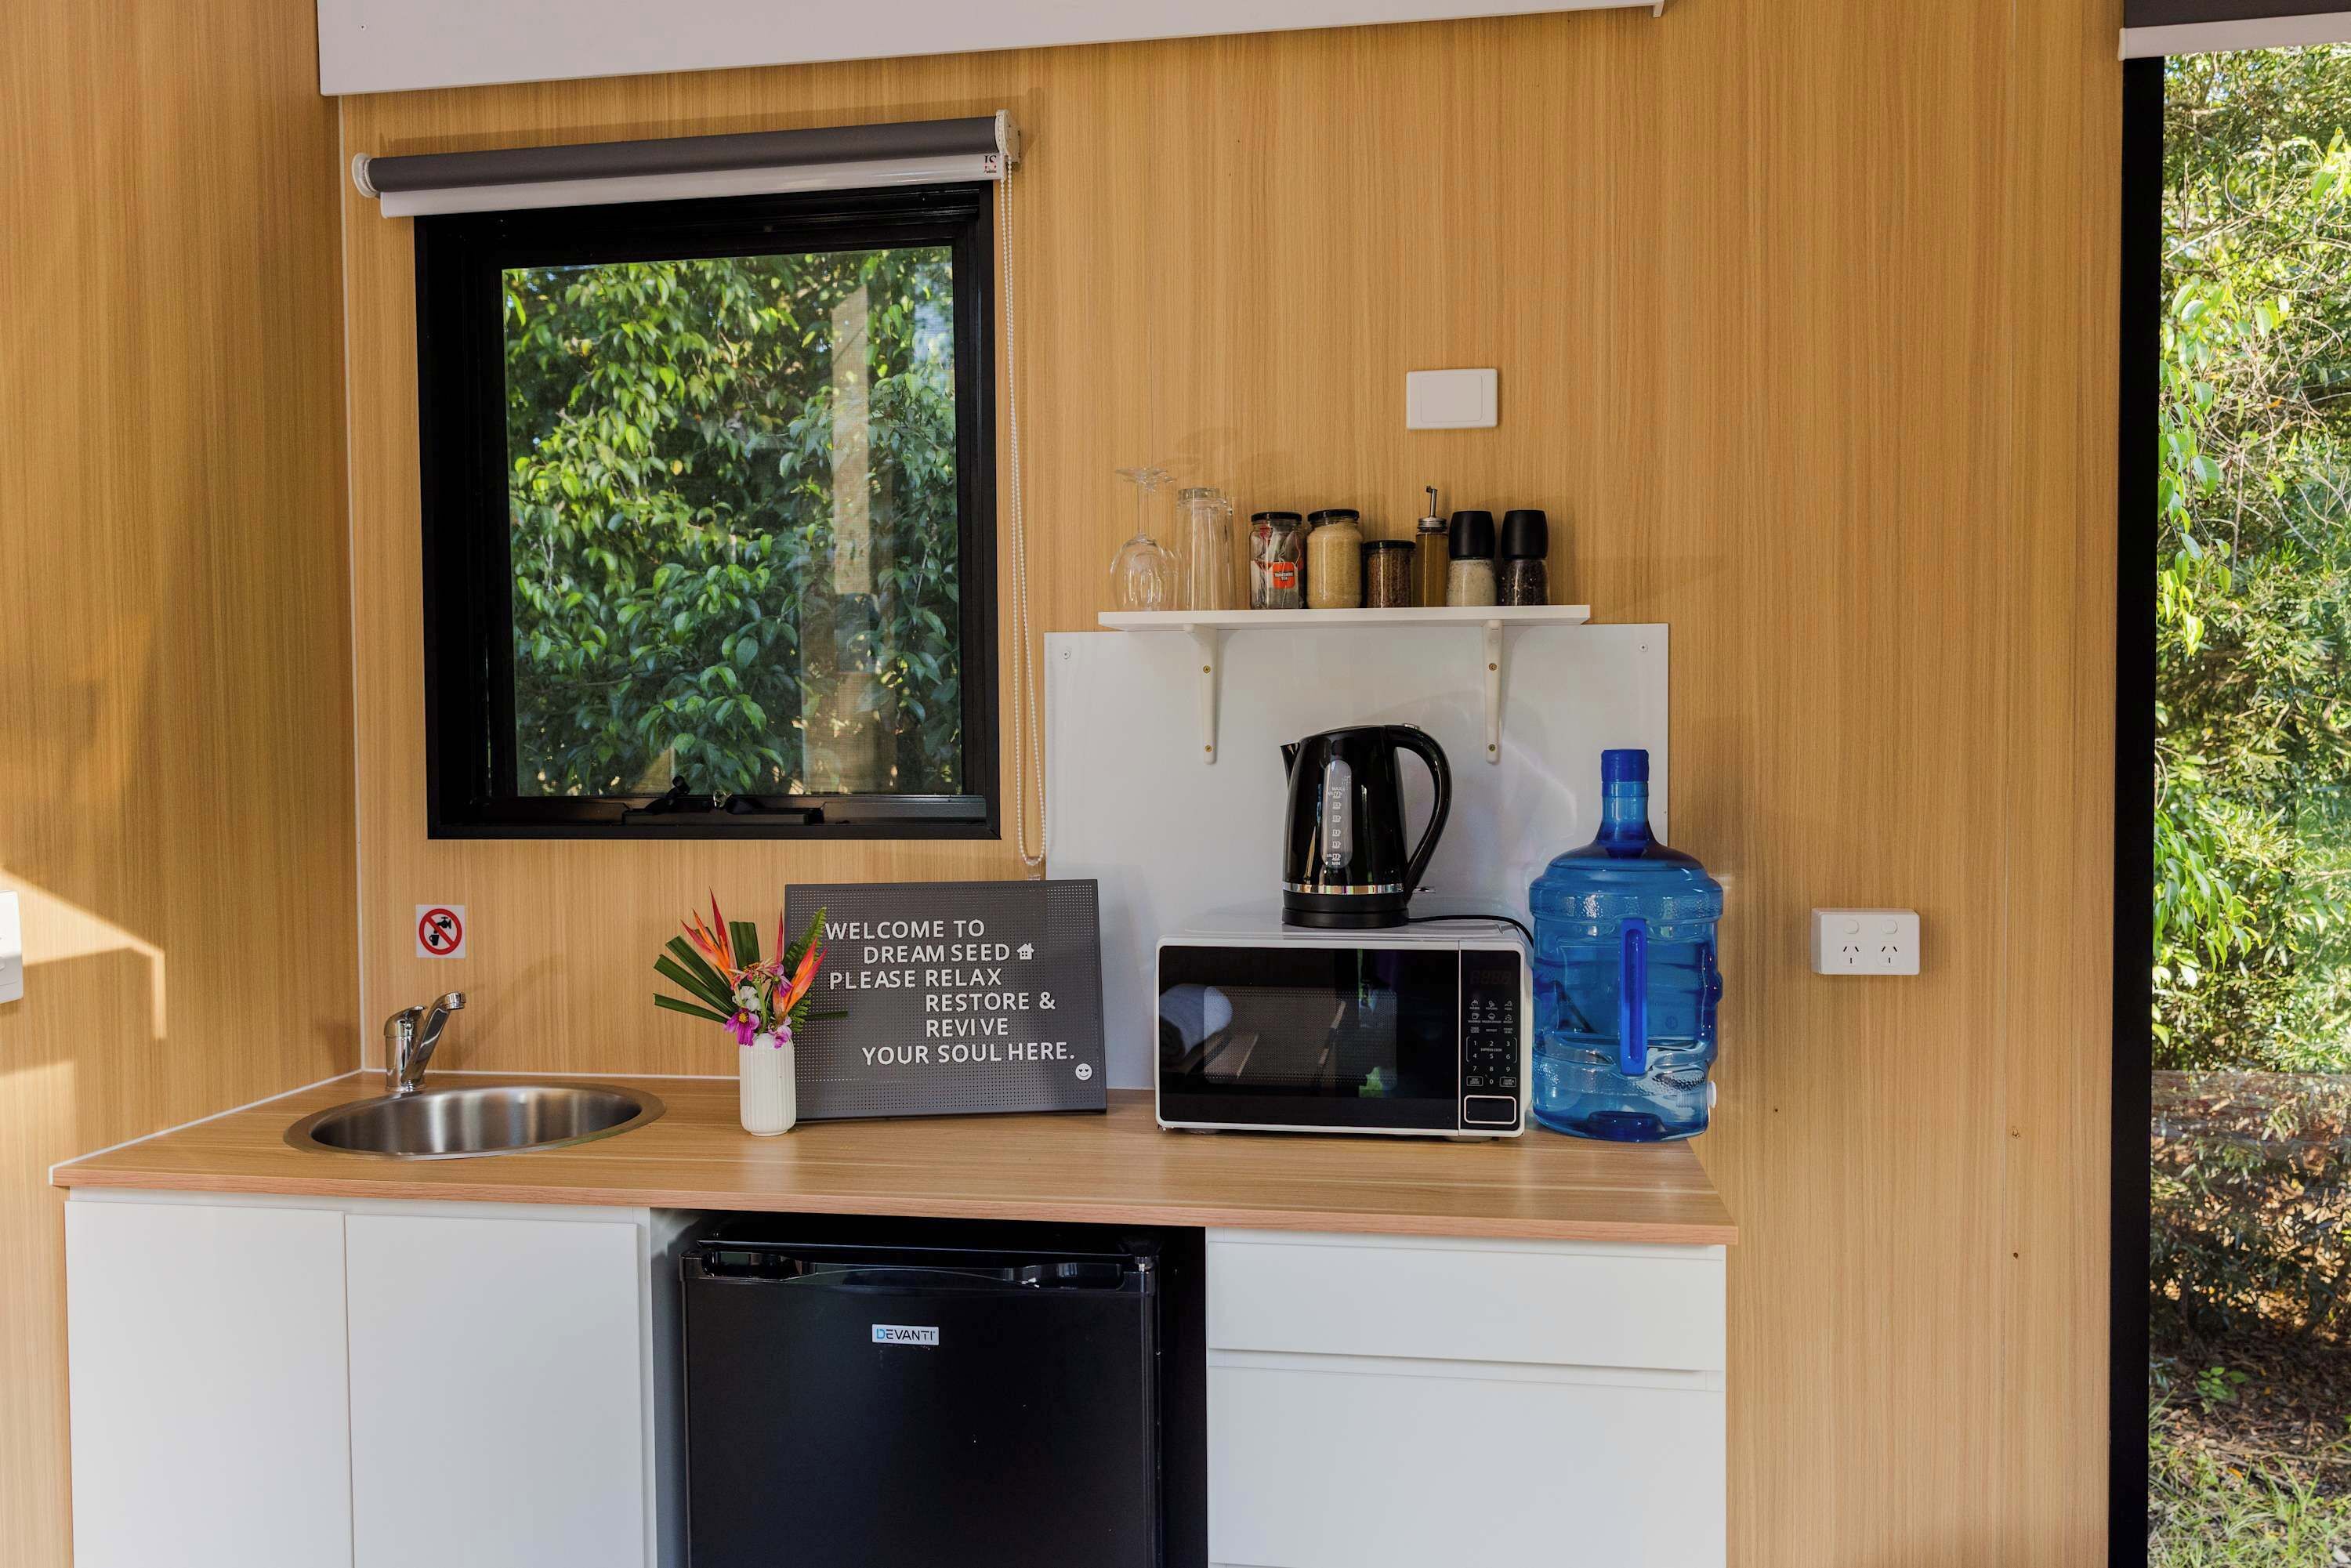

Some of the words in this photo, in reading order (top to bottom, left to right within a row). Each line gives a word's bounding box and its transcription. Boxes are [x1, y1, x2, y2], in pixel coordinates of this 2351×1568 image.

[824, 920, 944, 940] WELCOME
[953, 918, 985, 938] TO
[864, 944, 945, 965] DREAM
[951, 943, 1011, 962] SEED
[829, 969, 916, 990] PLEASE
[925, 968, 1002, 987] RELAX
[926, 991, 1031, 1012] RESTORE
[1038, 991, 1056, 1011] &
[926, 1018, 1009, 1038] REVIVE
[861, 1045, 930, 1066] YOUR
[937, 1042, 1002, 1063] SOUL
[1008, 1041, 1075, 1061] HERE.
[875, 1327, 933, 1341] DEVANTI
